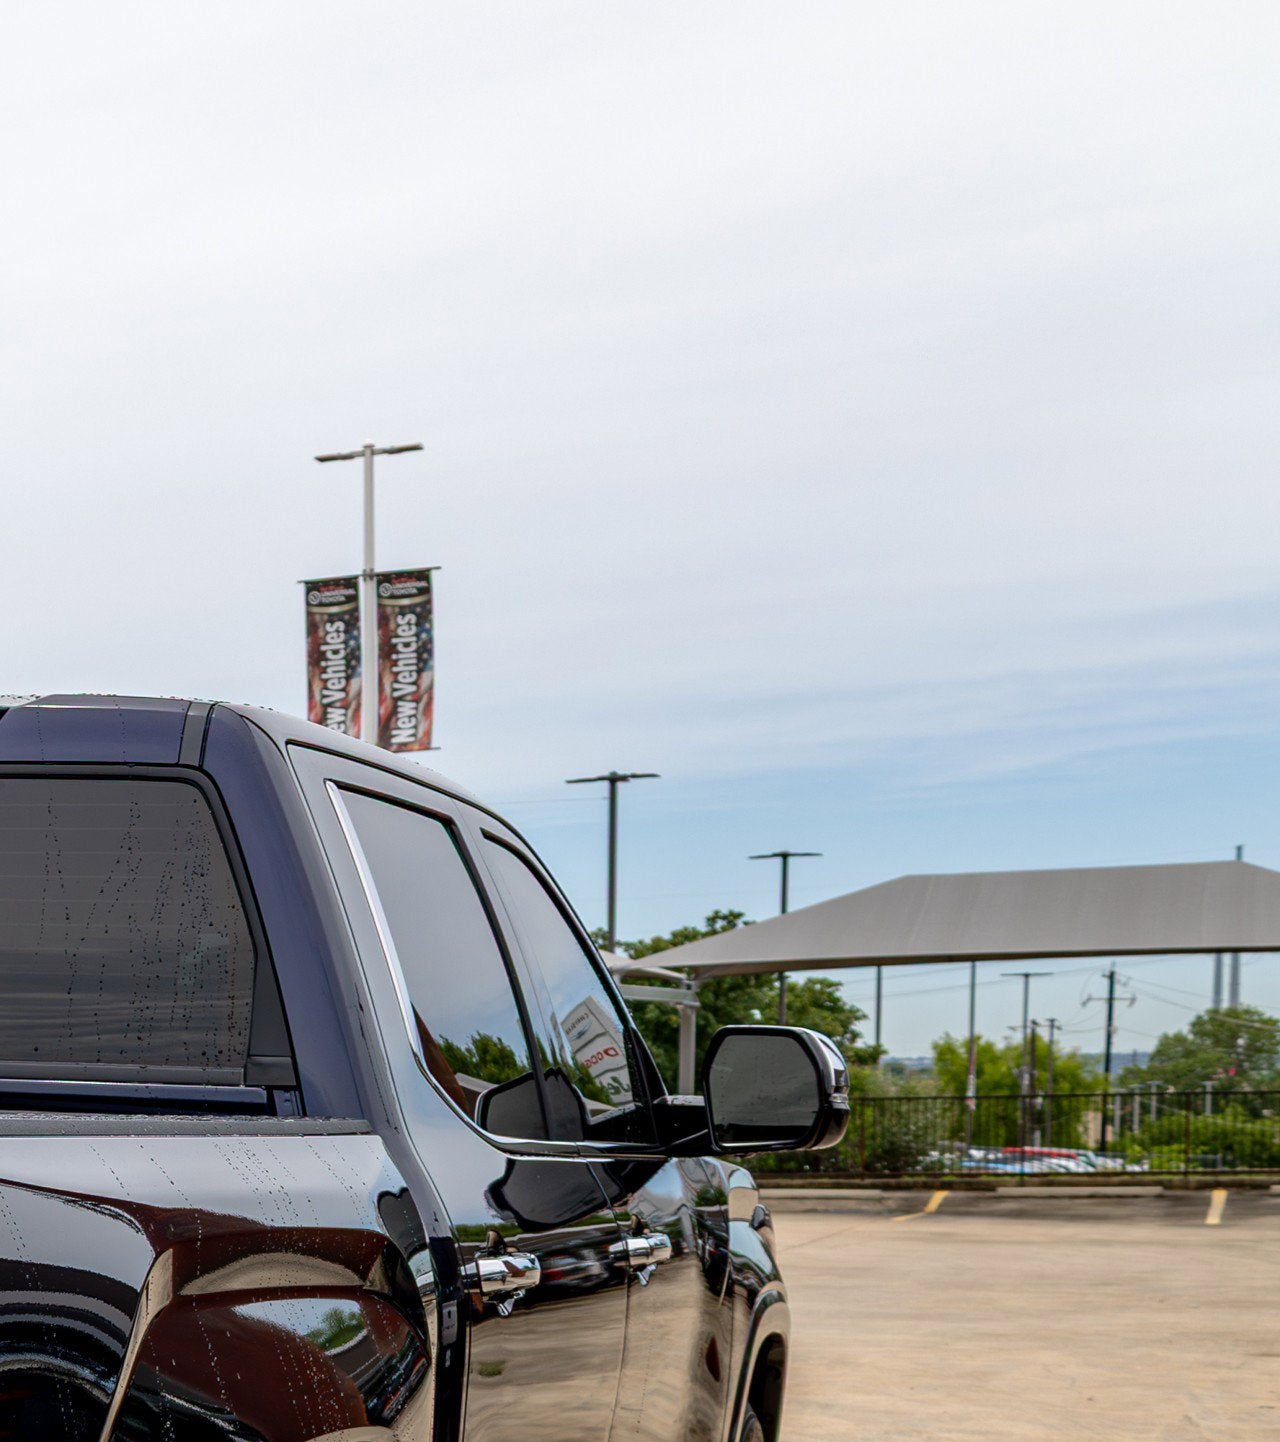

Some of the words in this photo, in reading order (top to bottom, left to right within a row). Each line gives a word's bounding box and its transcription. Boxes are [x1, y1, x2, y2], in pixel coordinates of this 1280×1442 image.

[320, 621, 347, 705] Vehicles
[391, 613, 418, 698] Vehicles
[327, 706, 347, 733] ew
[391, 701, 417, 744] New
